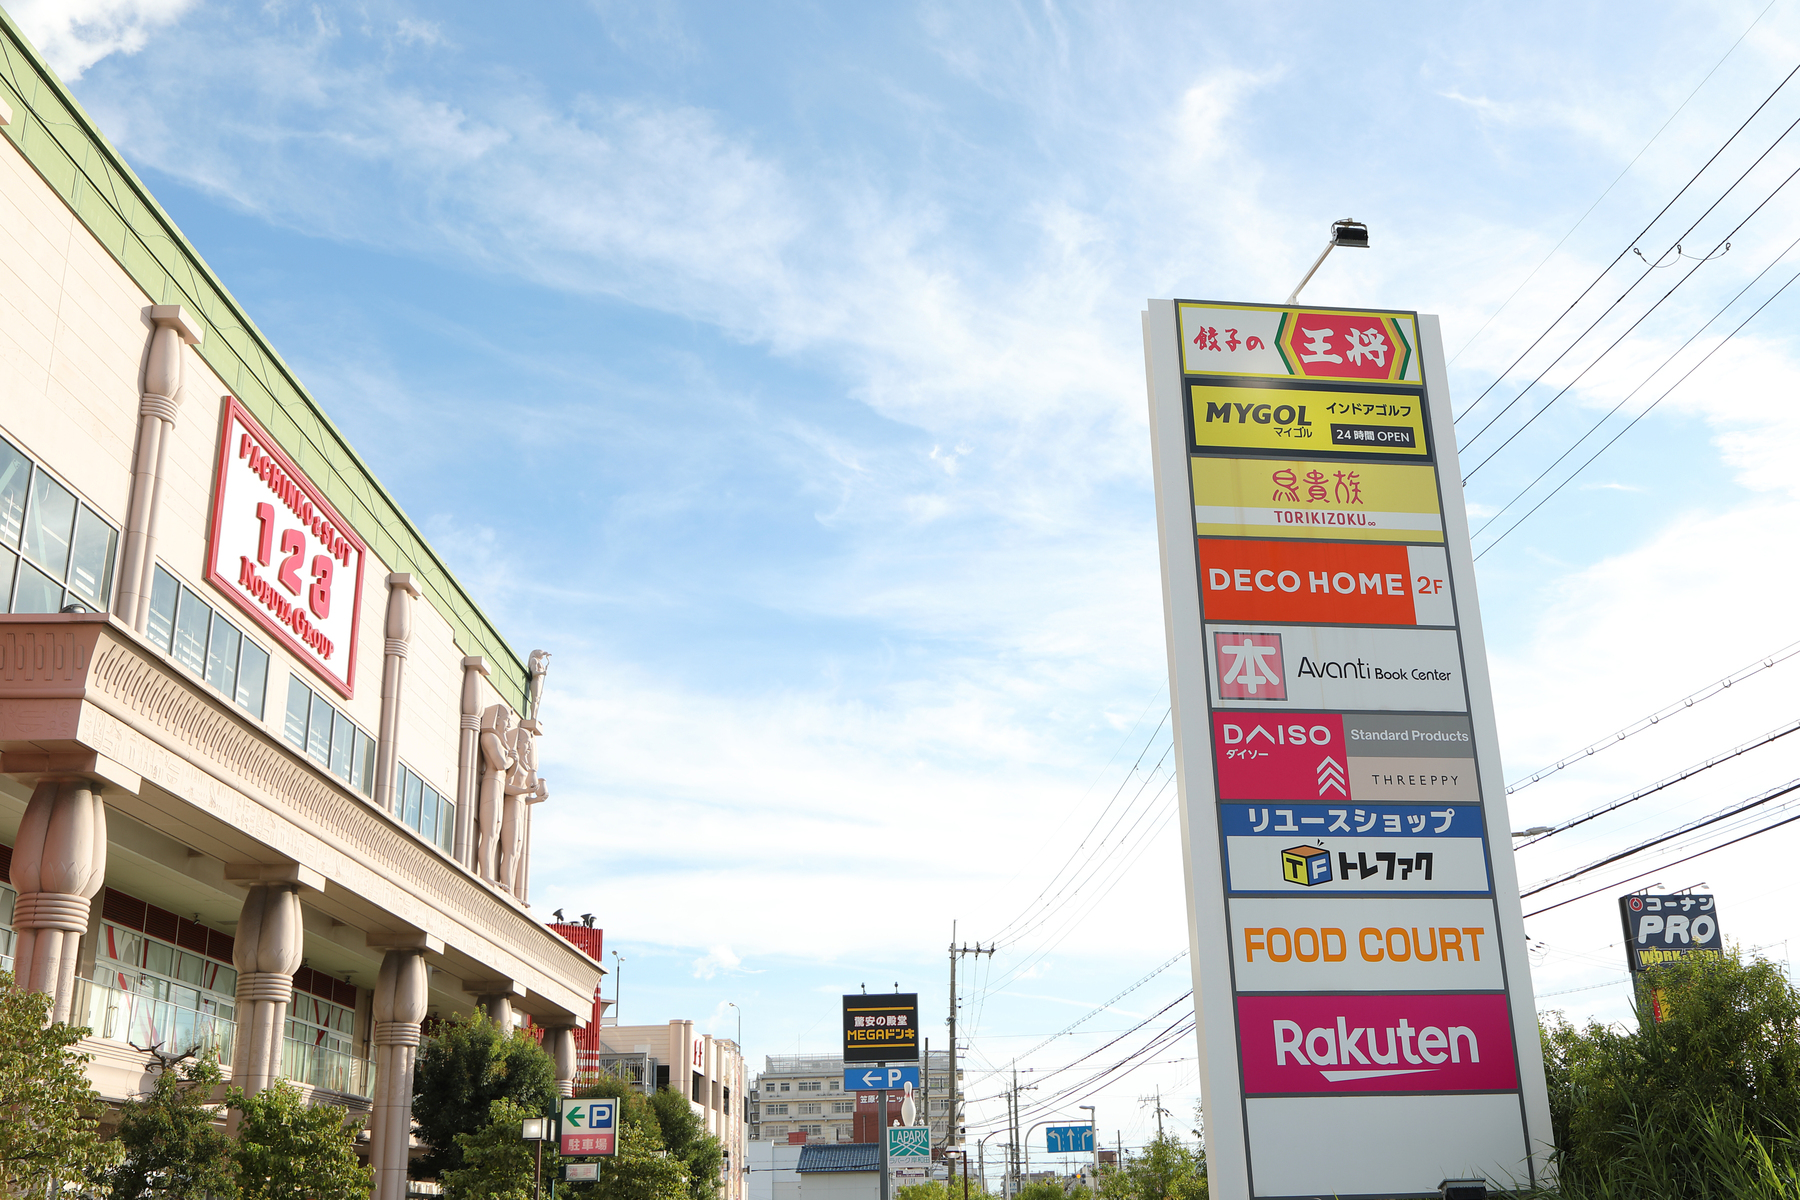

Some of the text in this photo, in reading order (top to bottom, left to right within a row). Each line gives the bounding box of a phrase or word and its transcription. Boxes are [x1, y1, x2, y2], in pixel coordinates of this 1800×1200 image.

[1194, 326, 1388, 368] 餃子の 王将
[1206, 402, 1312, 426] MYGOL
[1326, 402, 1412, 417] インドアゴルフ
[1274, 427, 1312, 438] マイゴル
[1336, 430, 1409, 442] 24 時間 OPEN
[1272, 469, 1364, 504] 鳥貴族
[1209, 568, 1442, 596] DECO HOME 2F
[1222, 638, 1280, 694] 本
[1298, 657, 1451, 681] Avanti Book Center
[1223, 724, 1331, 746] DAISO
[1351, 728, 1469, 743] Standard Products
[1226, 749, 1268, 760] ダイソー
[1372, 774, 1458, 786] THREEPPY
[1248, 808, 1455, 834] リユースショップ
[1339, 852, 1433, 880] トレファク
[1646, 897, 1713, 911] コーナン
[1638, 915, 1716, 944] PRO
[1244, 927, 1484, 963] FOOD COURT
[1640, 950, 1680, 965] WORK
[854, 1015, 908, 1027] 驚安の殿堂
[848, 1028, 914, 1040] MEGAドンキ
[1273, 1016, 1480, 1066] Rakuten
[888, 1069, 902, 1088] P
[592, 1107, 610, 1126] P
[568, 1138, 607, 1151] 駐車場
[892, 1130, 928, 1143] LAPARK
